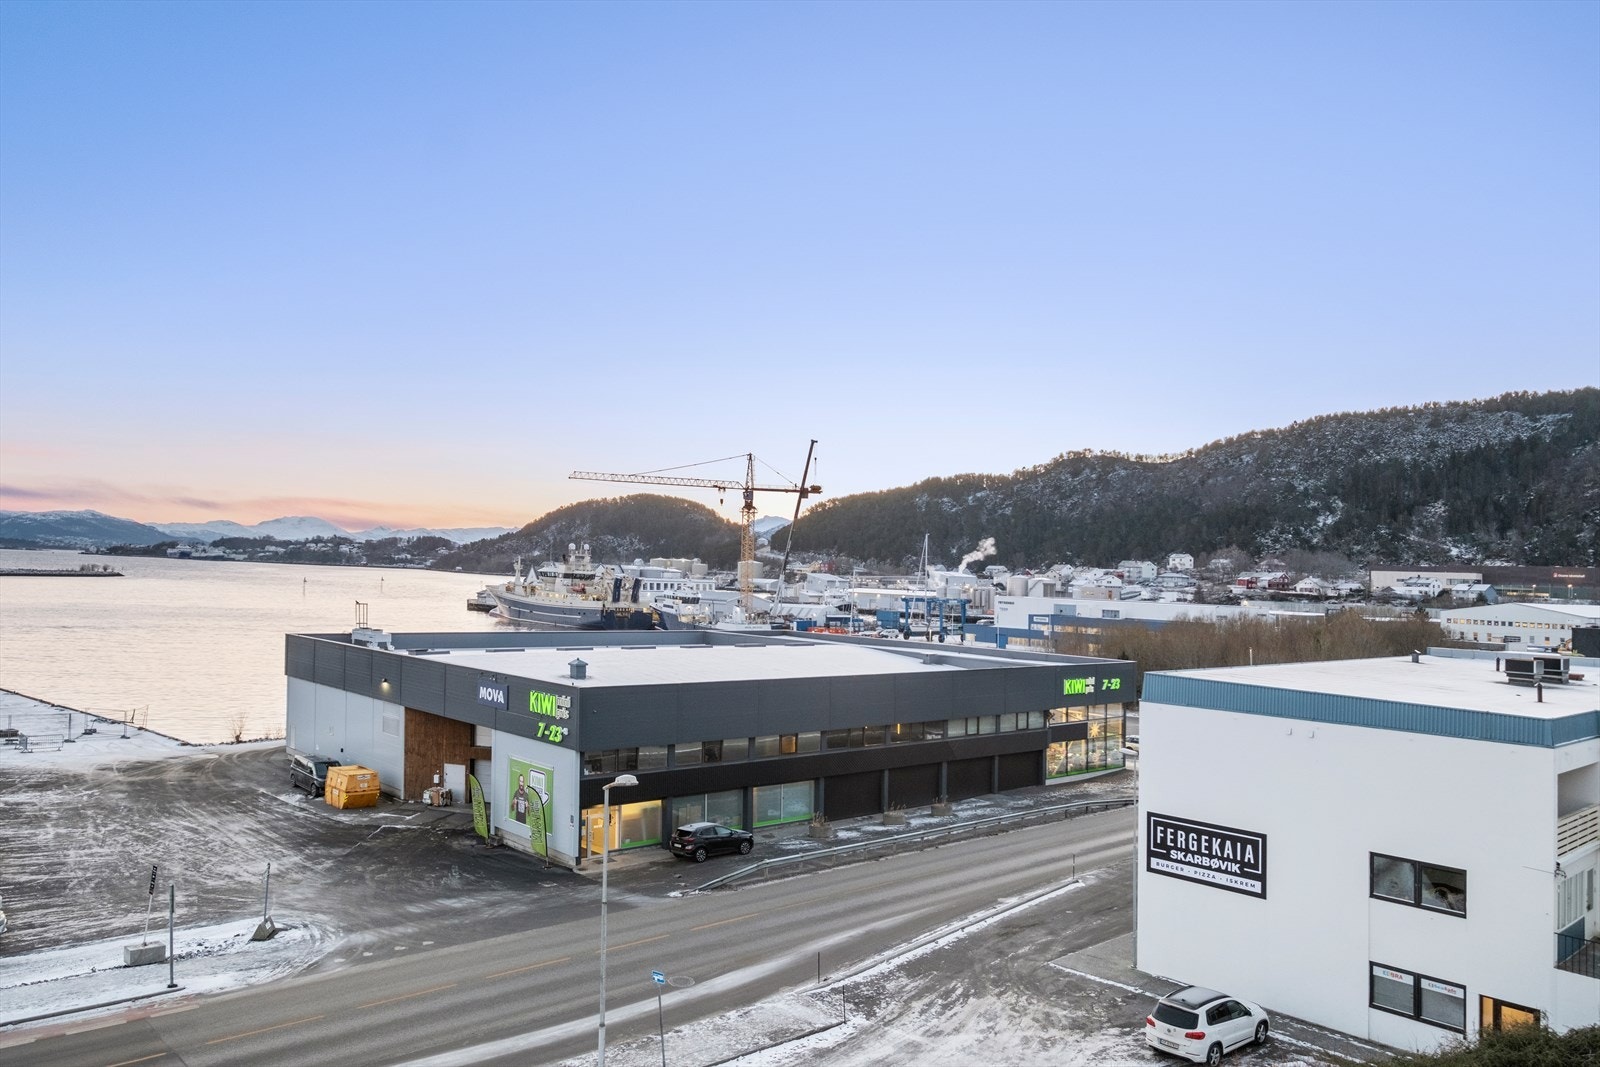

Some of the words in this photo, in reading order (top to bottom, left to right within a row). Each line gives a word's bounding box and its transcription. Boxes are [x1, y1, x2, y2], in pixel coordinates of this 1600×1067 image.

[479, 686, 505, 704] MOVA
[1064, 678, 1086, 695] KIWI
[1101, 678, 1120, 690] 7-23
[529, 690, 556, 717] KIWI
[537, 722, 563, 743] 7-23
[1156, 826, 1255, 864] FERGEKAIA
[1170, 849, 1241, 874] SKARBØVIK
[1155, 861, 1185, 873] BURGER
[1193, 870, 1217, 880] PIZZA
[1226, 878, 1256, 889] ISKREM
